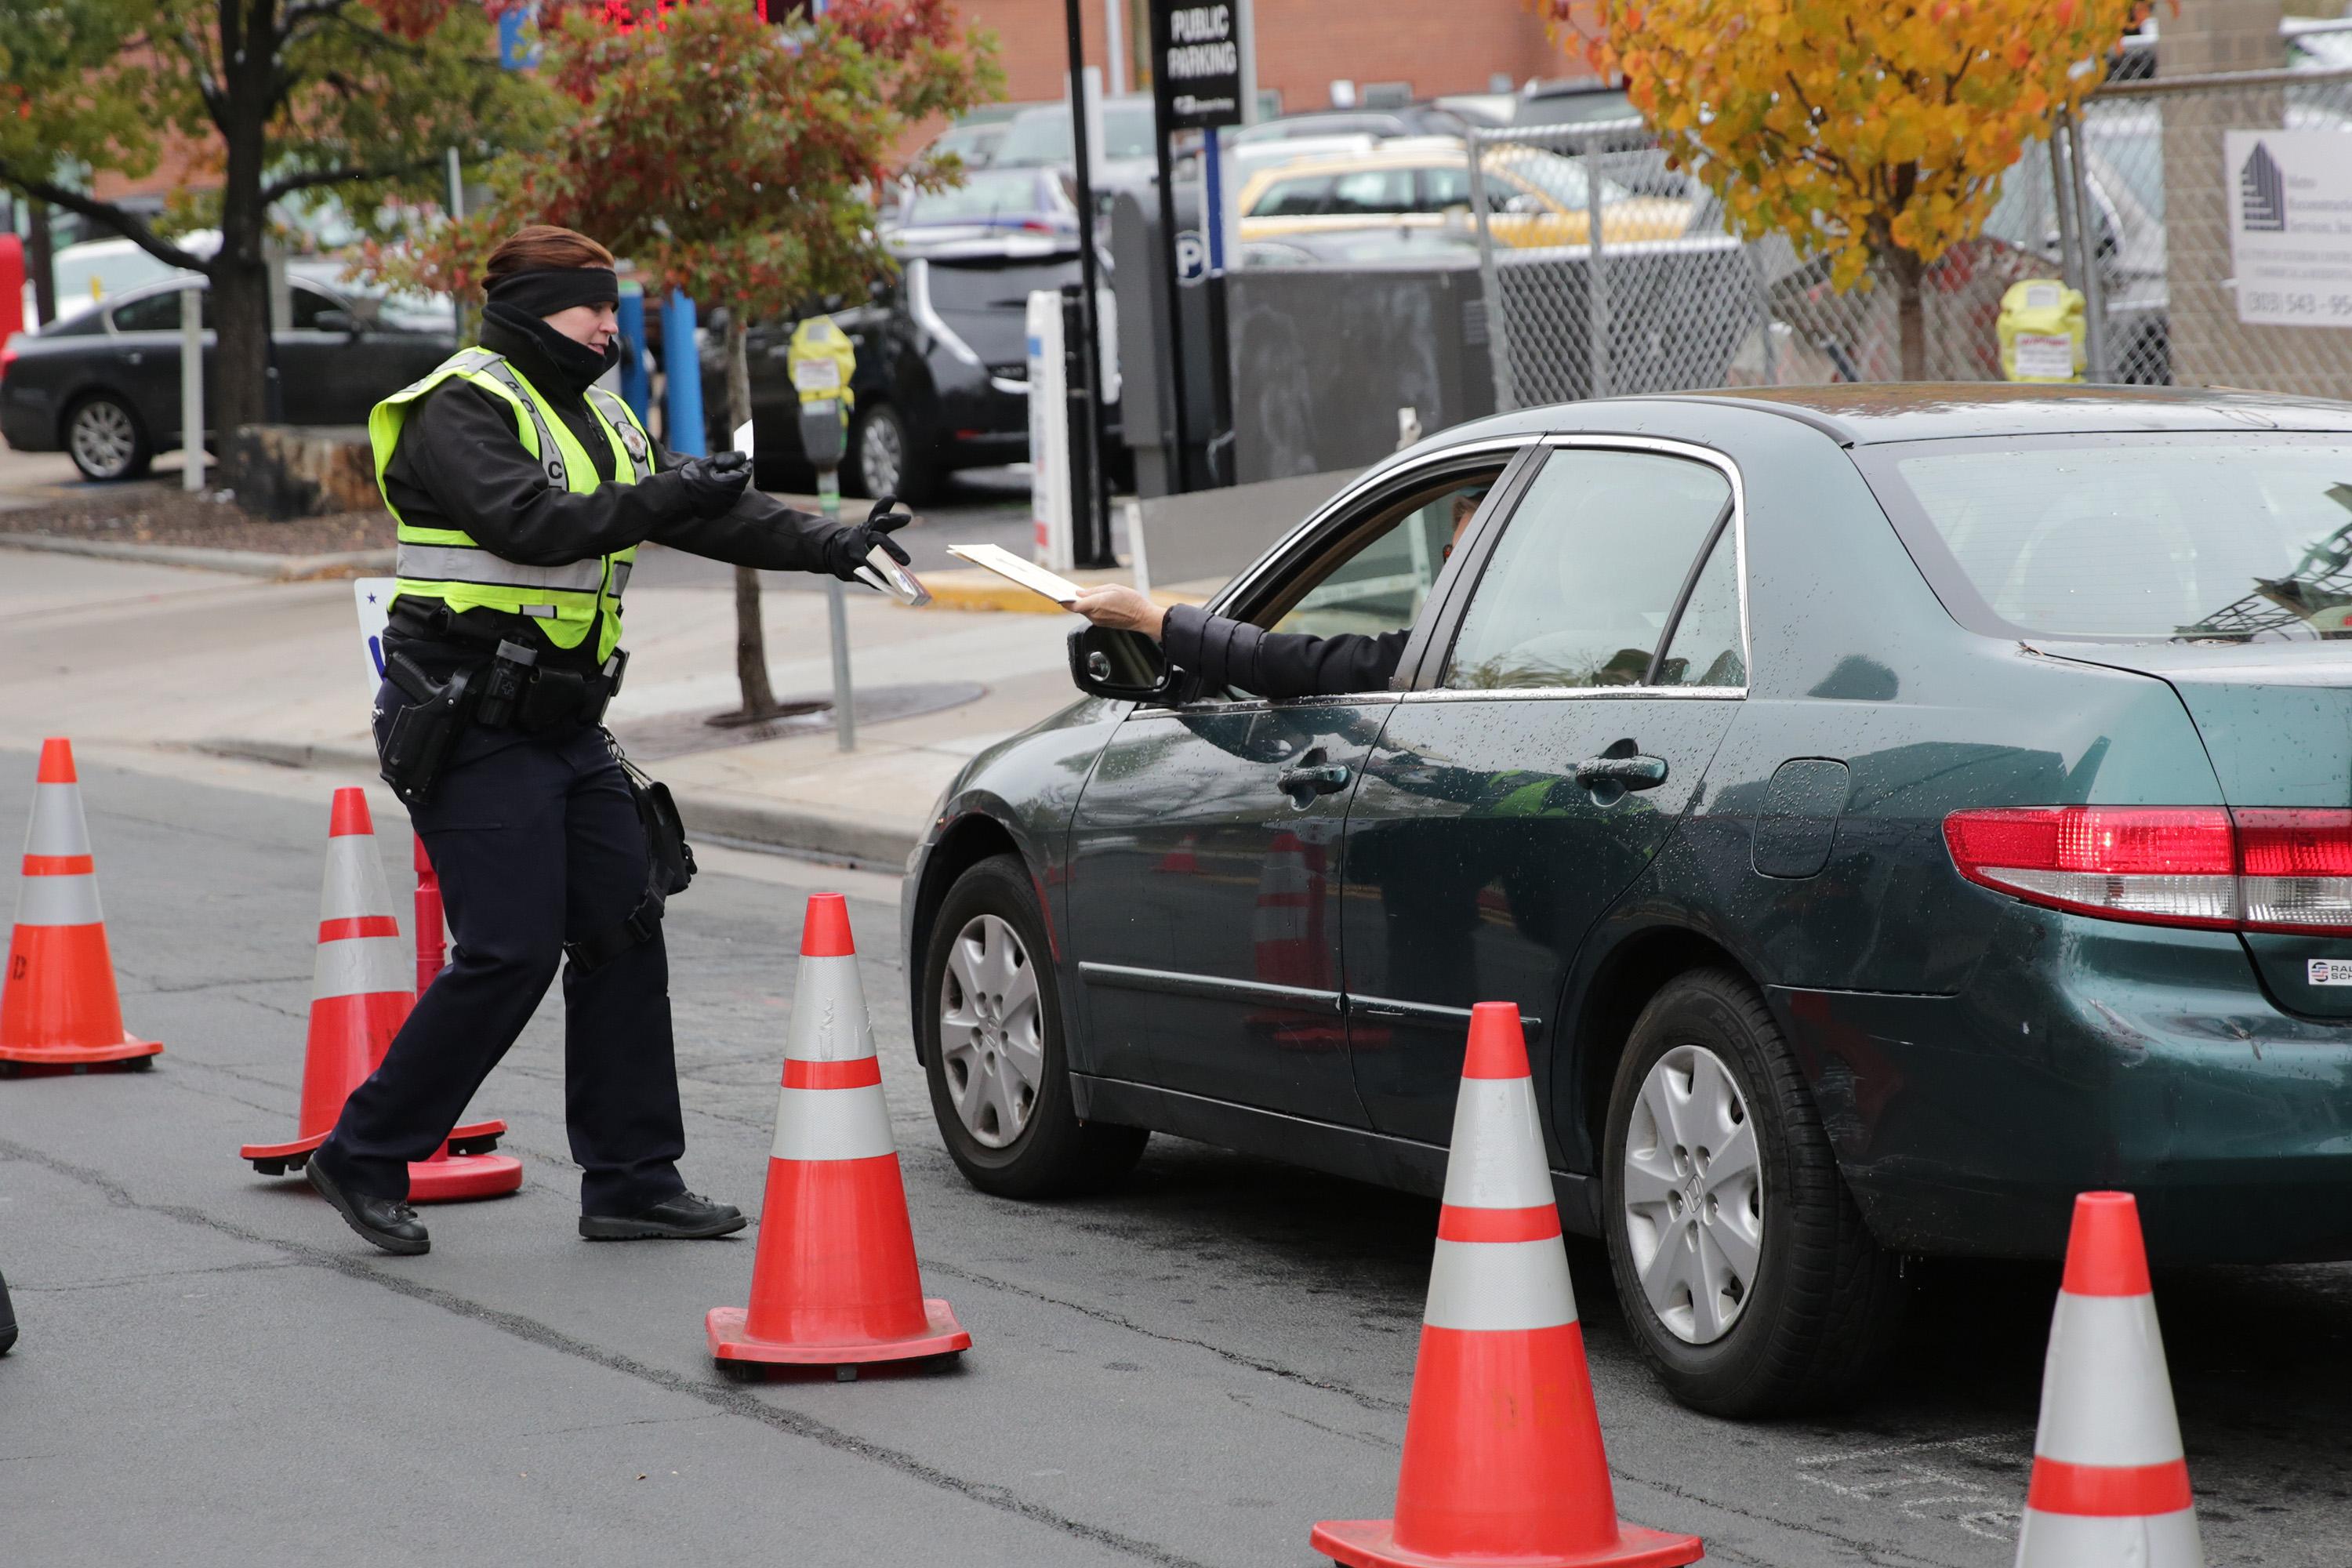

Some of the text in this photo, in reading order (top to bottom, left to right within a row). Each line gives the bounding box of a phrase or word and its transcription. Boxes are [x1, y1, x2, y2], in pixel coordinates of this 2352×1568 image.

[1171, 4, 1229, 42] PUBLIC
[1167, 40, 1237, 78] PARKING
[1178, 240, 1202, 276] P
[504, 381, 563, 489] POLIC
